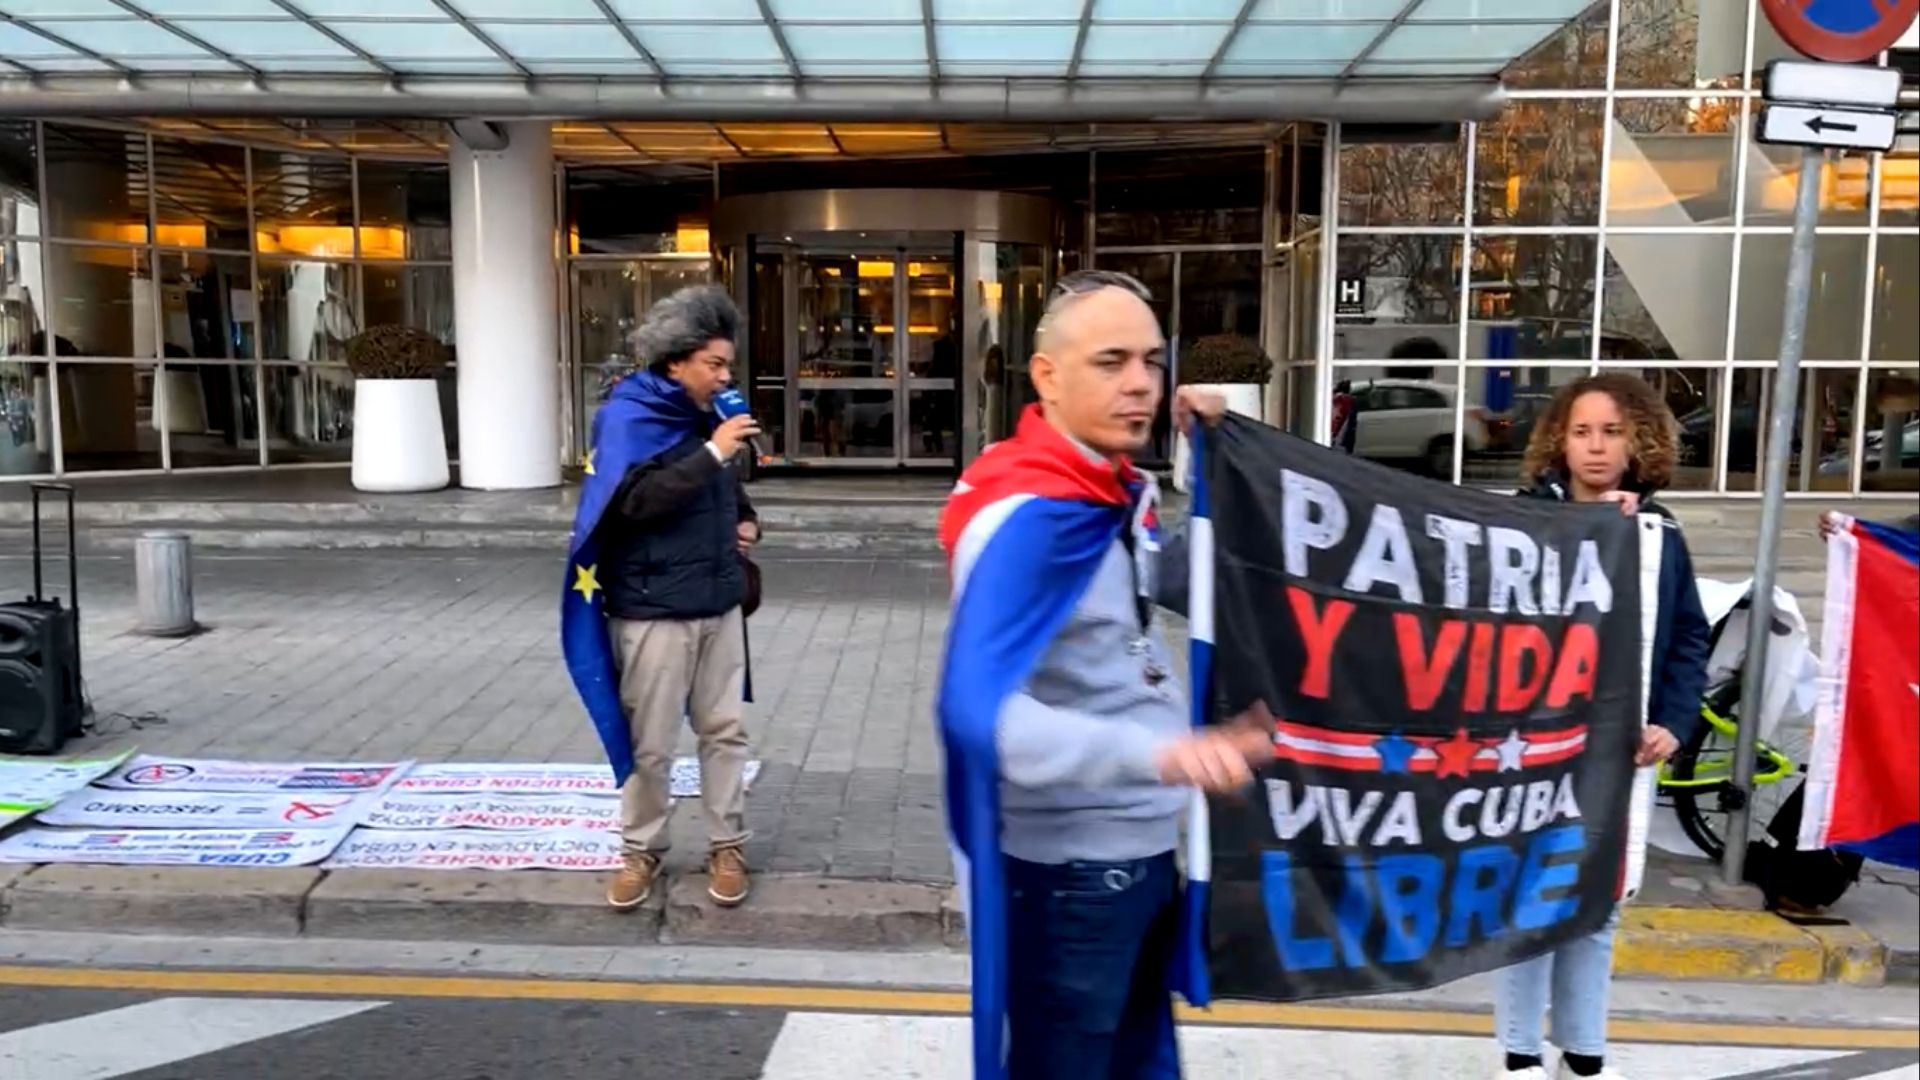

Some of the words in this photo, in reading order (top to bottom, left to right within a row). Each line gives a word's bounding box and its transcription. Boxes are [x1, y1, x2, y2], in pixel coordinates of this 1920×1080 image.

[1341, 280, 1360, 302] H
[1281, 468, 1612, 615] PATRIA
[1286, 586, 1356, 699] Y
[1393, 613, 1598, 712] VIDA
[84, 801, 225, 815] FASCISMO
[1264, 778, 1422, 846] VIVA
[1443, 773, 1581, 841] CUBA
[198, 852, 291, 864] CUBA
[464, 840, 600, 854] DICTADURA
[1261, 824, 1585, 972] LIBRE
